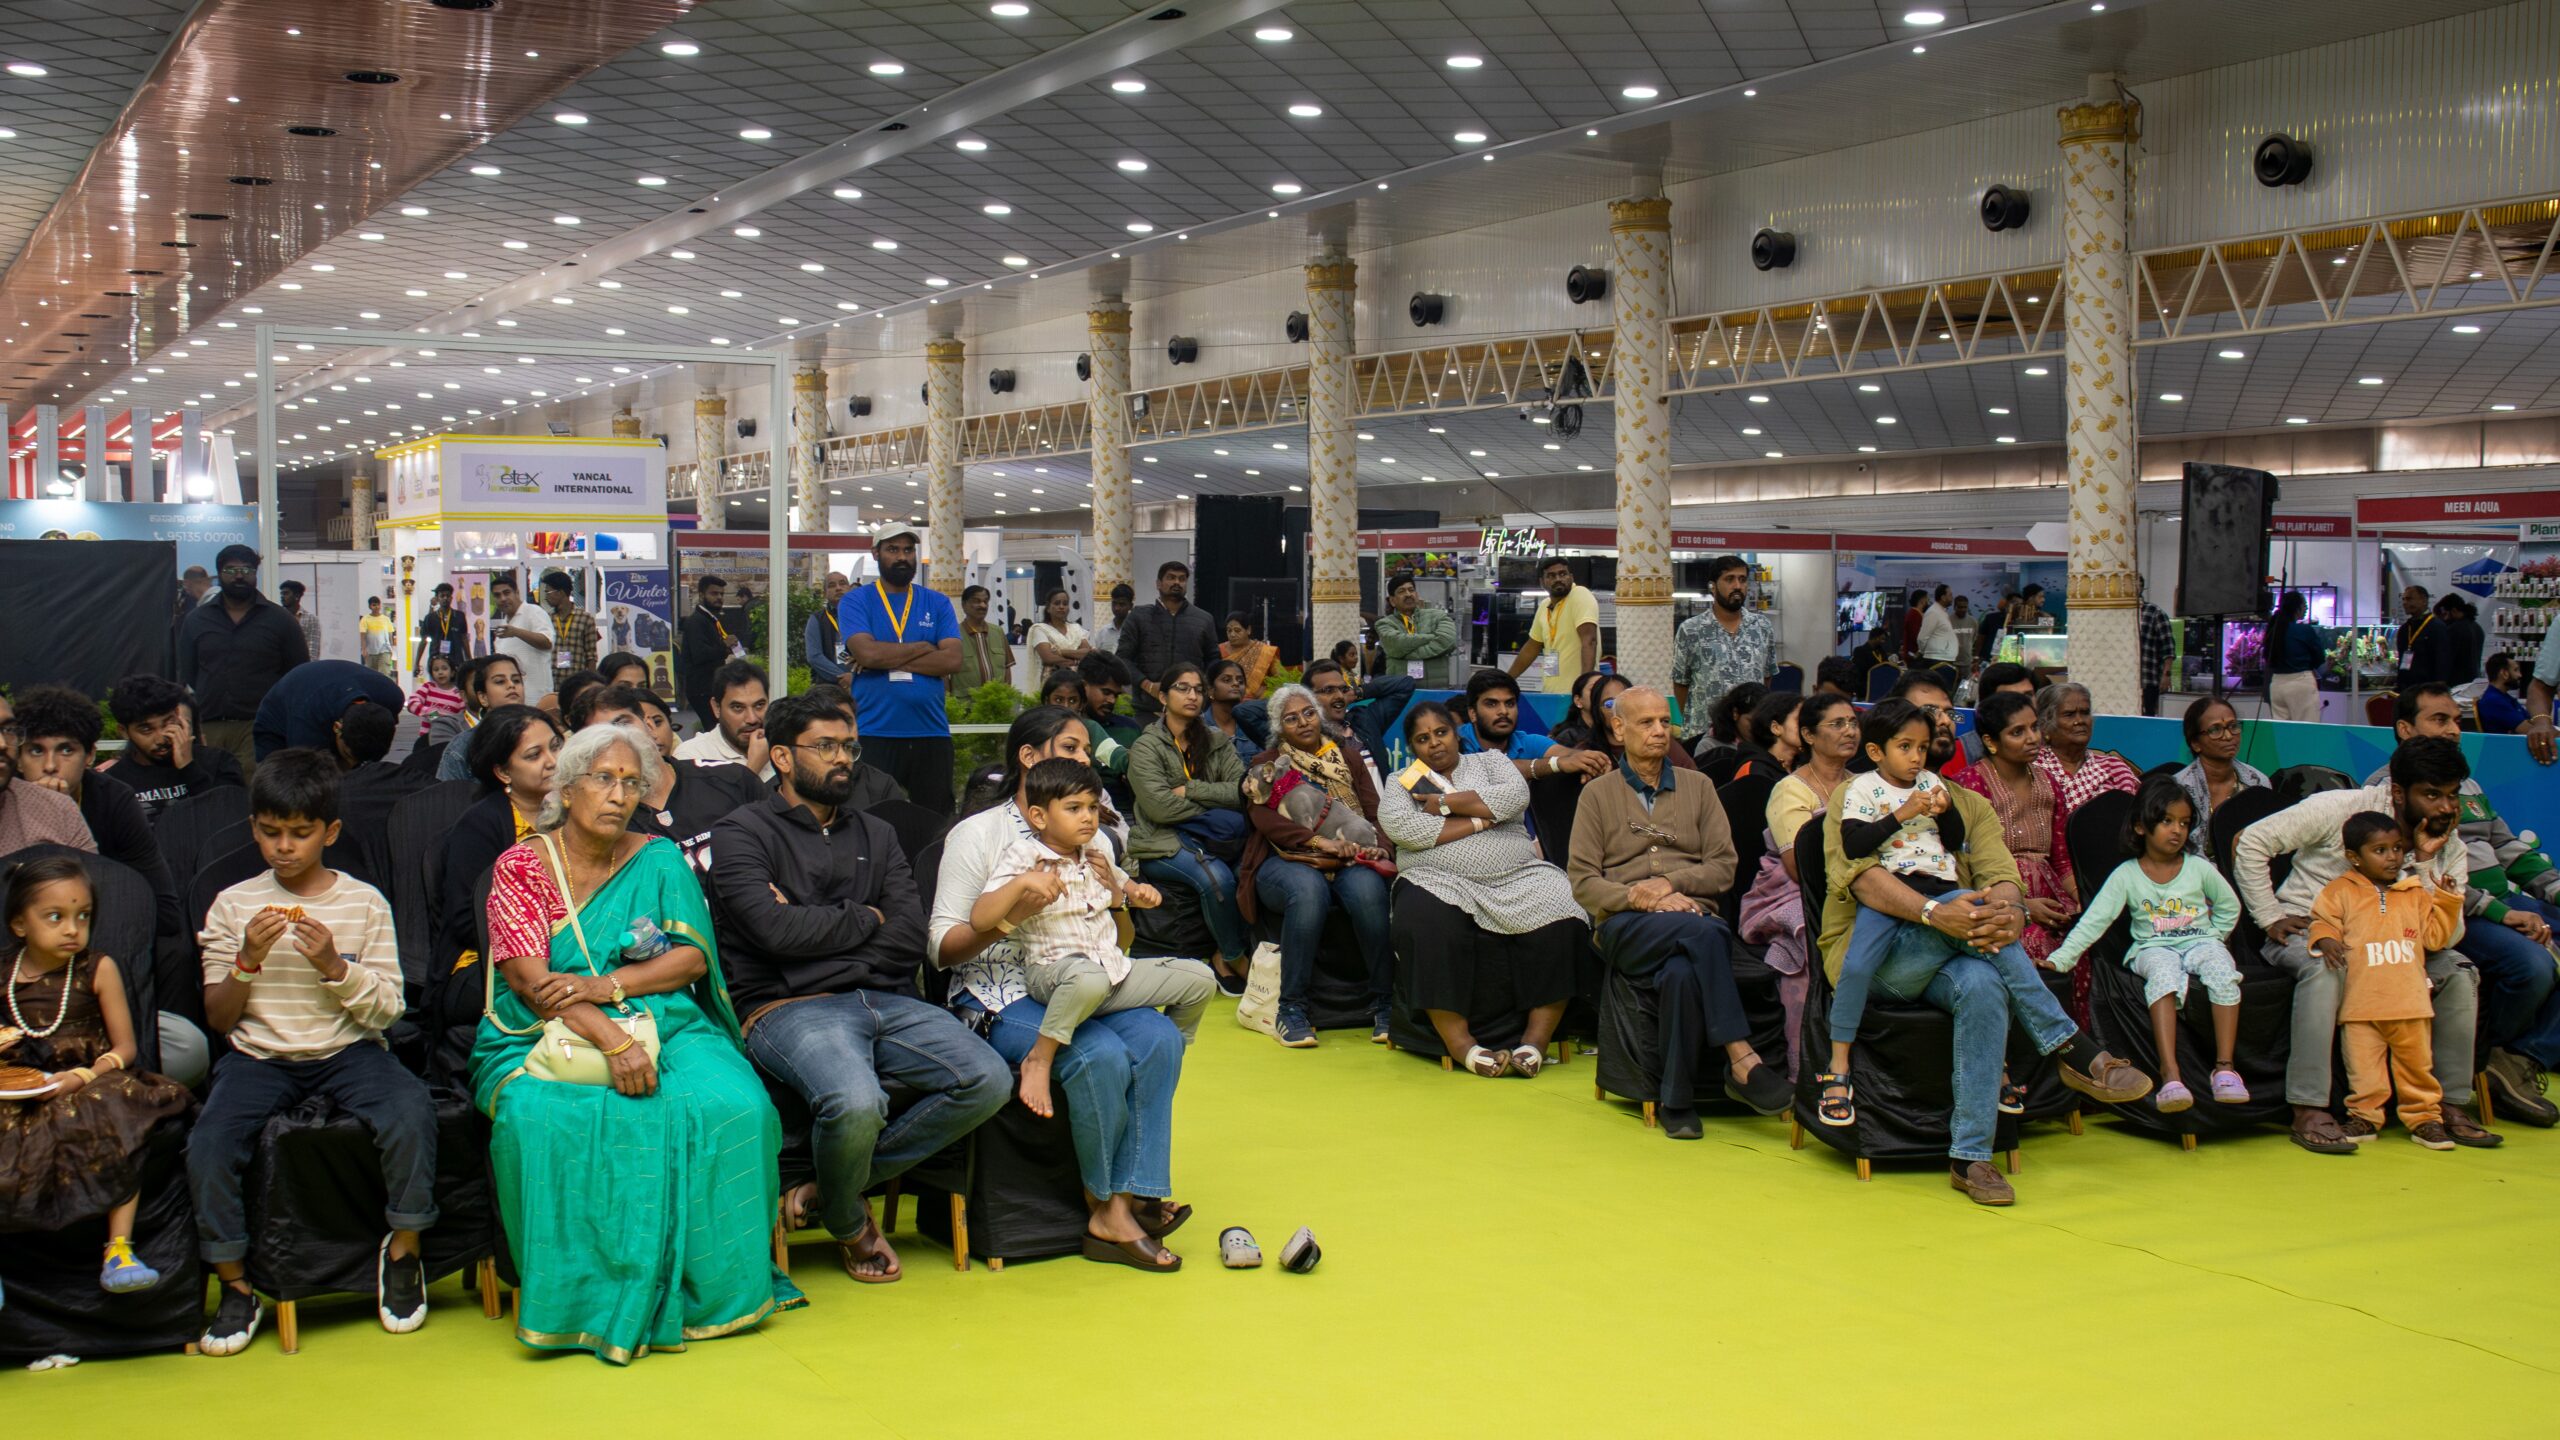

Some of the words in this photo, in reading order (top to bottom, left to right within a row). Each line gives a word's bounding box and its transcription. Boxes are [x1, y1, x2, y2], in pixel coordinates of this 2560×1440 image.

[572, 472, 612, 481] YANCAL
[554, 484, 633, 494] INTERNATIONAL
[2444, 502, 2471, 513] MEEN
[2473, 501, 2500, 513] AQUA
[2287, 522, 2306, 531] PLANT
[2308, 523, 2335, 532] PLANETT
[167, 531, 200, 541] 95135
[204, 532, 244, 542] 00700
[1677, 536, 1691, 544] LETS
[1692, 536, 1701, 544] GO
[1702, 537, 1726, 545] FISHING
[1514, 529, 1547, 558] Fishing
[607, 581, 668, 600] Winter
